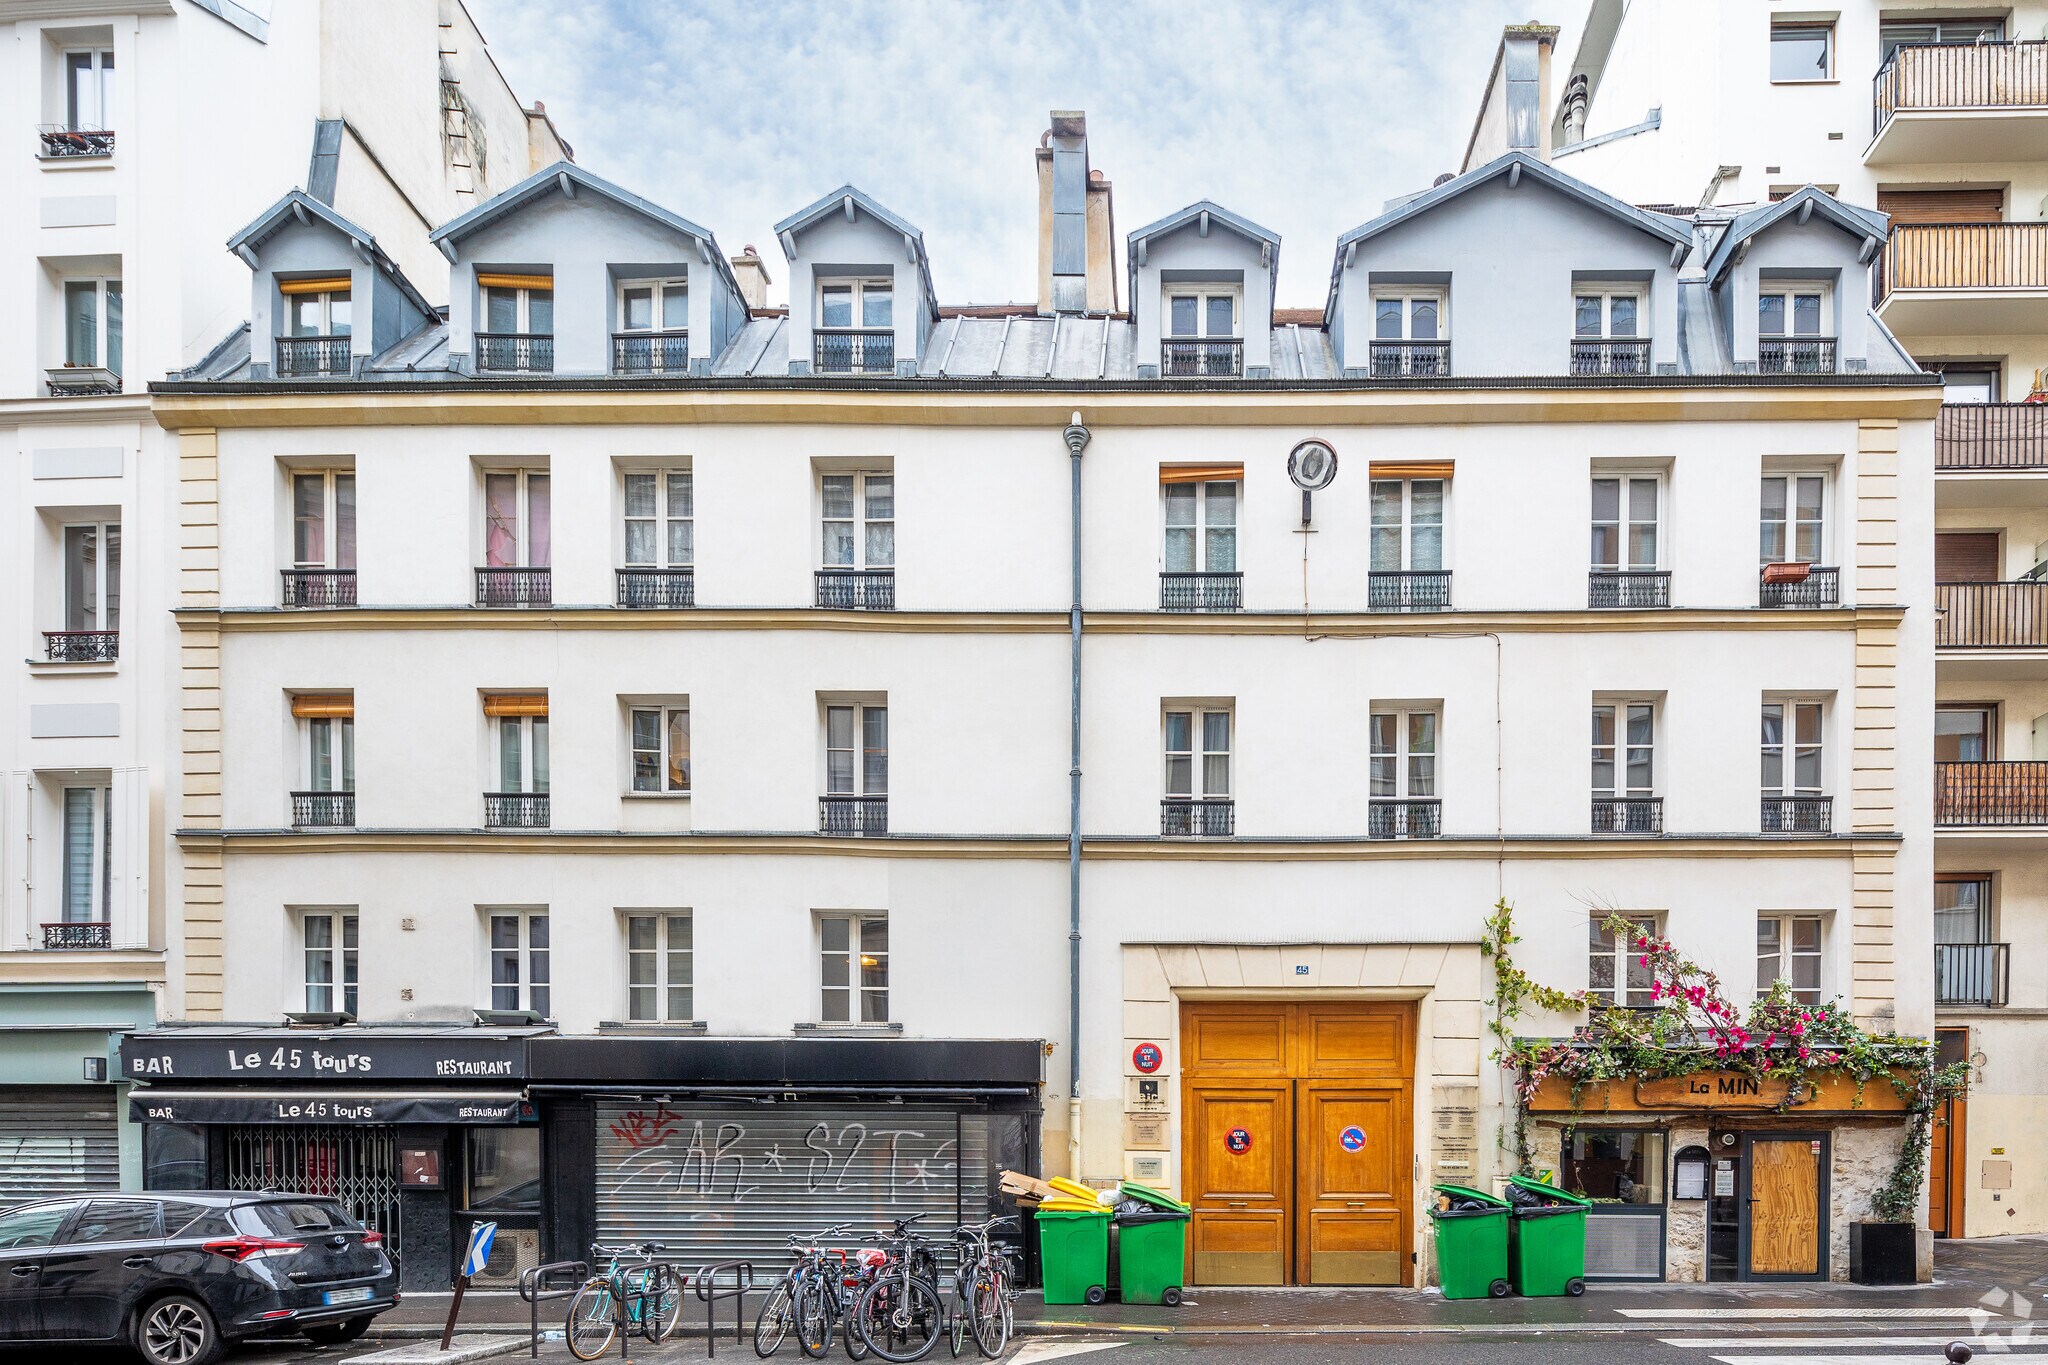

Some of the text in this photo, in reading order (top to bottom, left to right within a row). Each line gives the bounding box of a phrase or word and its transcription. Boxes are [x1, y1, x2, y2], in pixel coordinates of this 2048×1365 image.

[1297, 966, 1307, 974] 45
[133, 1056, 174, 1075] BAR
[228, 1049, 262, 1071] Le
[312, 1050, 372, 1073] tours
[436, 1059, 512, 1076] RESTAURANT
[1690, 1078, 1759, 1095] La MIN
[148, 1107, 174, 1119] BAR
[278, 1104, 301, 1118] Le
[333, 1103, 373, 1119] tours
[459, 1107, 508, 1117] RESTAURANT
